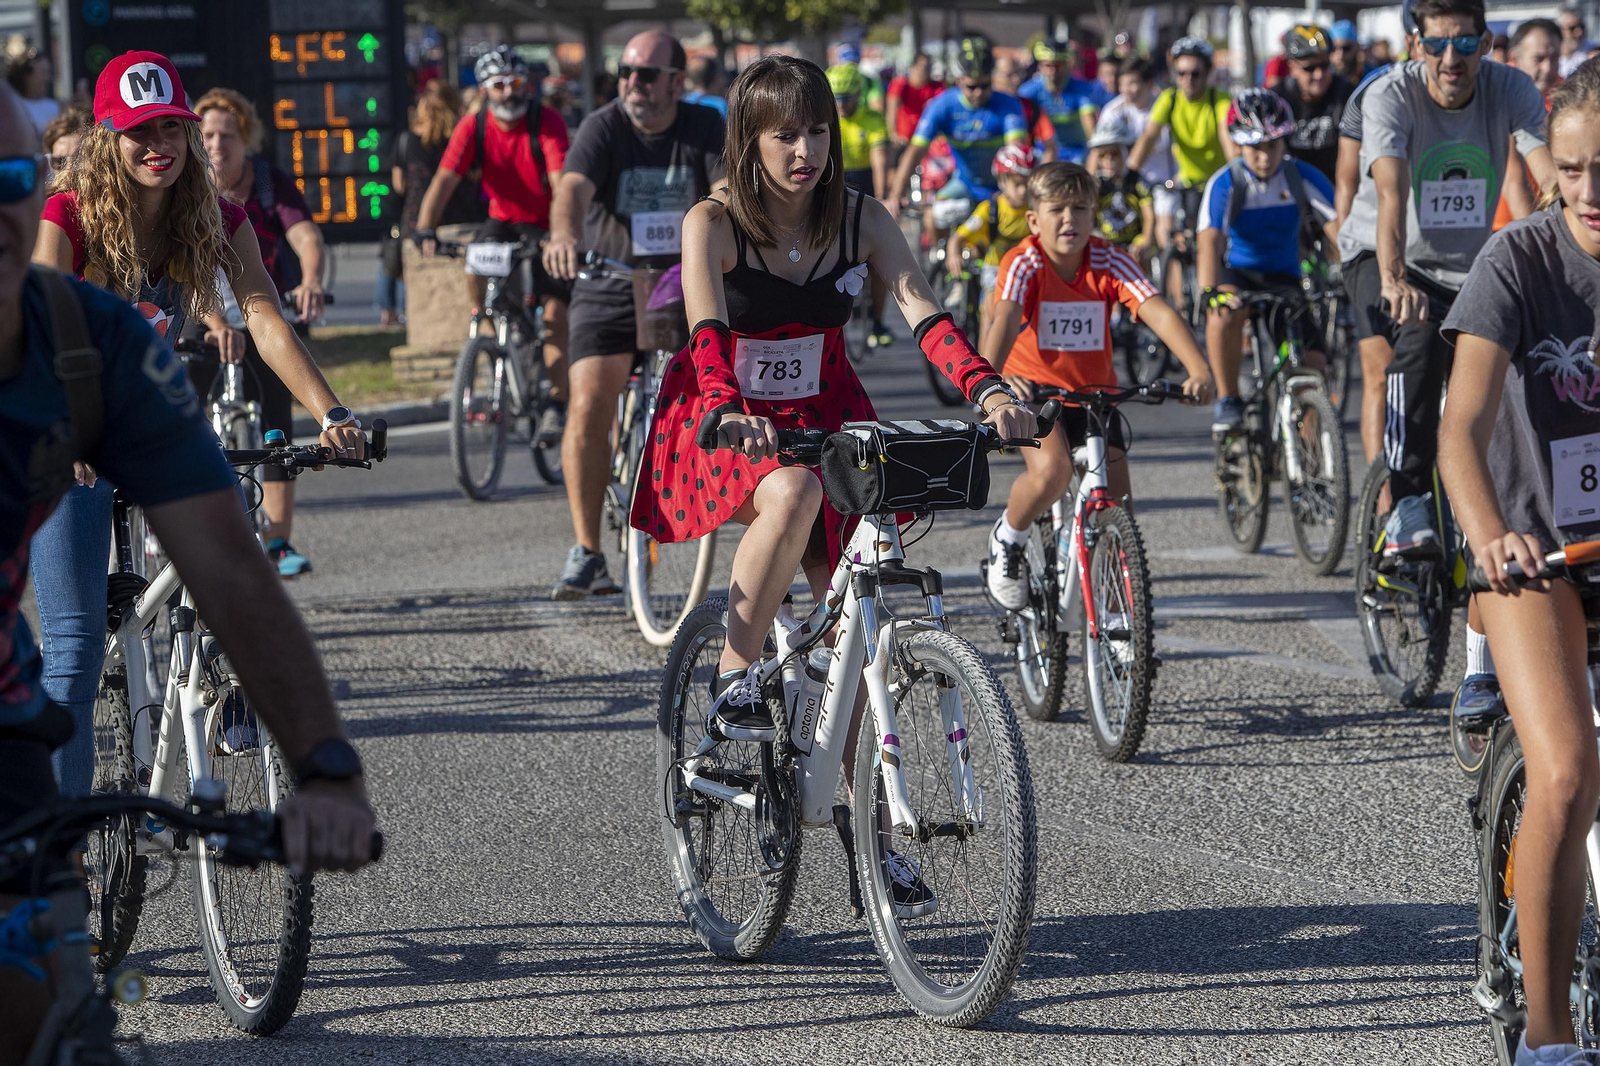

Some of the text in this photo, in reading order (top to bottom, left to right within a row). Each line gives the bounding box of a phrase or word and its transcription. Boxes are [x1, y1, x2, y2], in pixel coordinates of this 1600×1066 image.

[127, 69, 164, 101] M
[1431, 195, 1475, 213] 1793
[646, 225, 675, 242] 889
[1048, 318, 1092, 335] 1791
[757, 358, 802, 381] 783
[1580, 464, 1598, 492] 8
[800, 697, 816, 740] aptonia
[865, 881, 876, 911] Country
[687, 901, 707, 930] MICHELIN
[872, 911, 890, 955] MICHELIN
